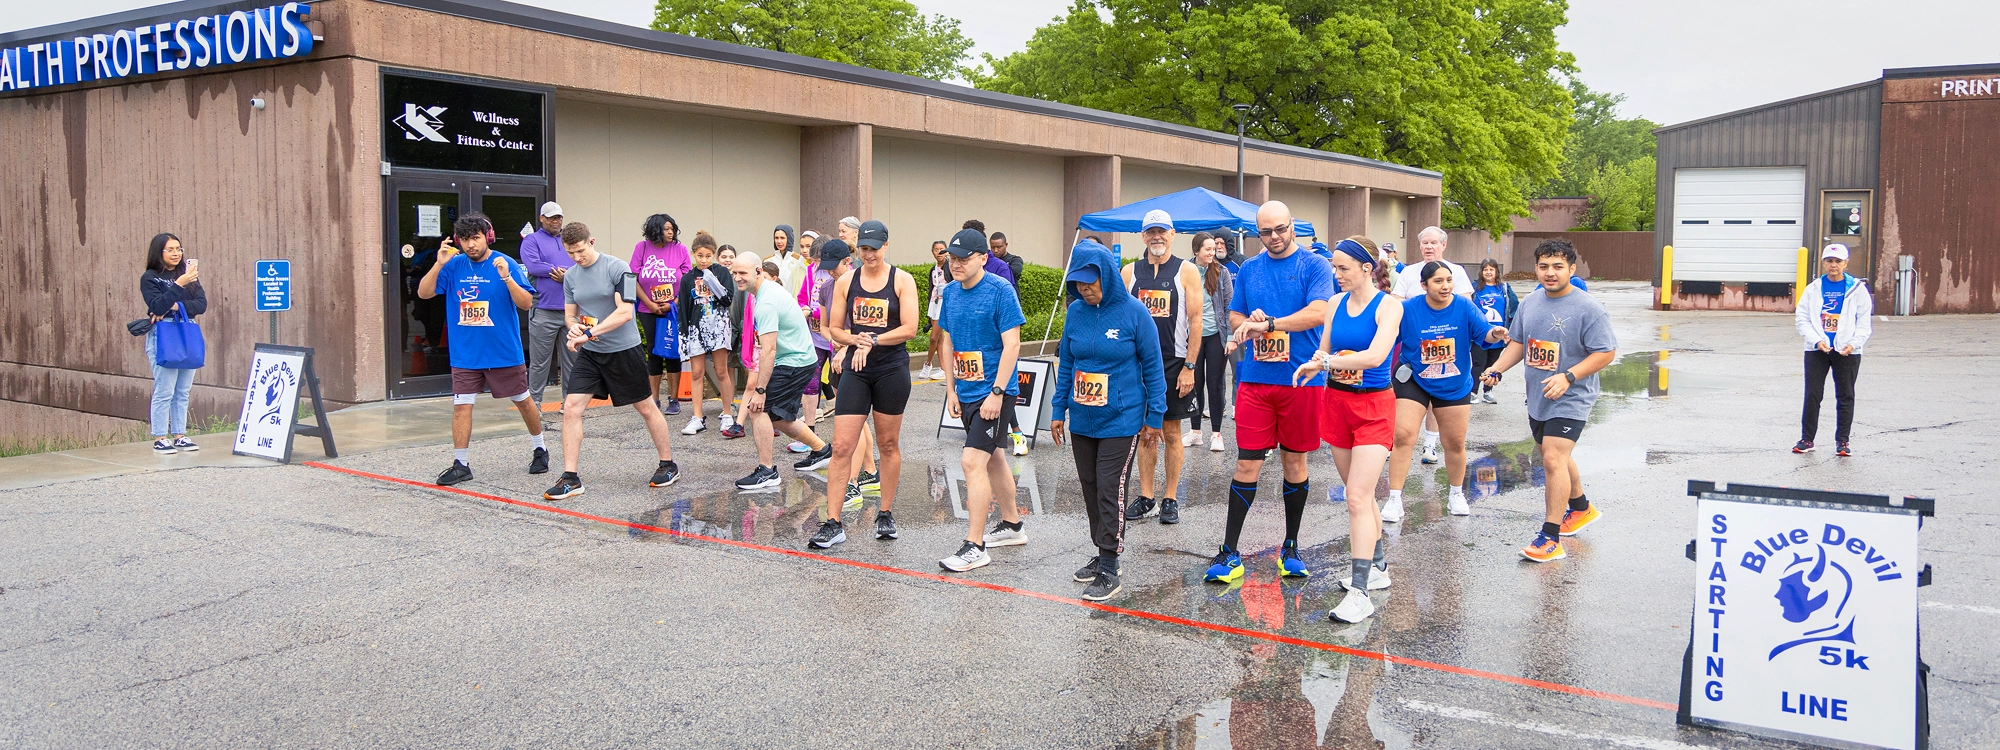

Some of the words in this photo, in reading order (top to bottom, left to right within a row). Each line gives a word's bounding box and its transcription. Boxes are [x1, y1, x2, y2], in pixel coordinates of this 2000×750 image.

[74, 2, 300, 82] PROFESSIONS
[472, 111, 520, 126] Wellness
[491, 127, 501, 136] &
[456, 134, 496, 148] Fitness
[498, 138, 534, 151] Center
[641, 269, 677, 279] WALK
[653, 288, 672, 299] 1849
[1140, 297, 1167, 310] 1840
[463, 307, 486, 318] 1853
[857, 305, 884, 319] 1823
[1256, 338, 1285, 353] 1820
[1426, 344, 1451, 357] 1851
[1529, 346, 1555, 362] 1836
[957, 359, 979, 373] 1815
[260, 363, 279, 385] Blue
[280, 361, 296, 387] Devil
[1076, 380, 1103, 397] 1822
[239, 358, 262, 444] STARTING
[269, 415, 282, 426] 5k
[257, 436, 273, 449] LINE
[1740, 528, 1809, 574] Blue
[1821, 523, 1902, 582] Devil
[1704, 514, 1728, 702] STARTING
[1818, 645, 1870, 671] 5k
[1781, 690, 1848, 721] LINE
